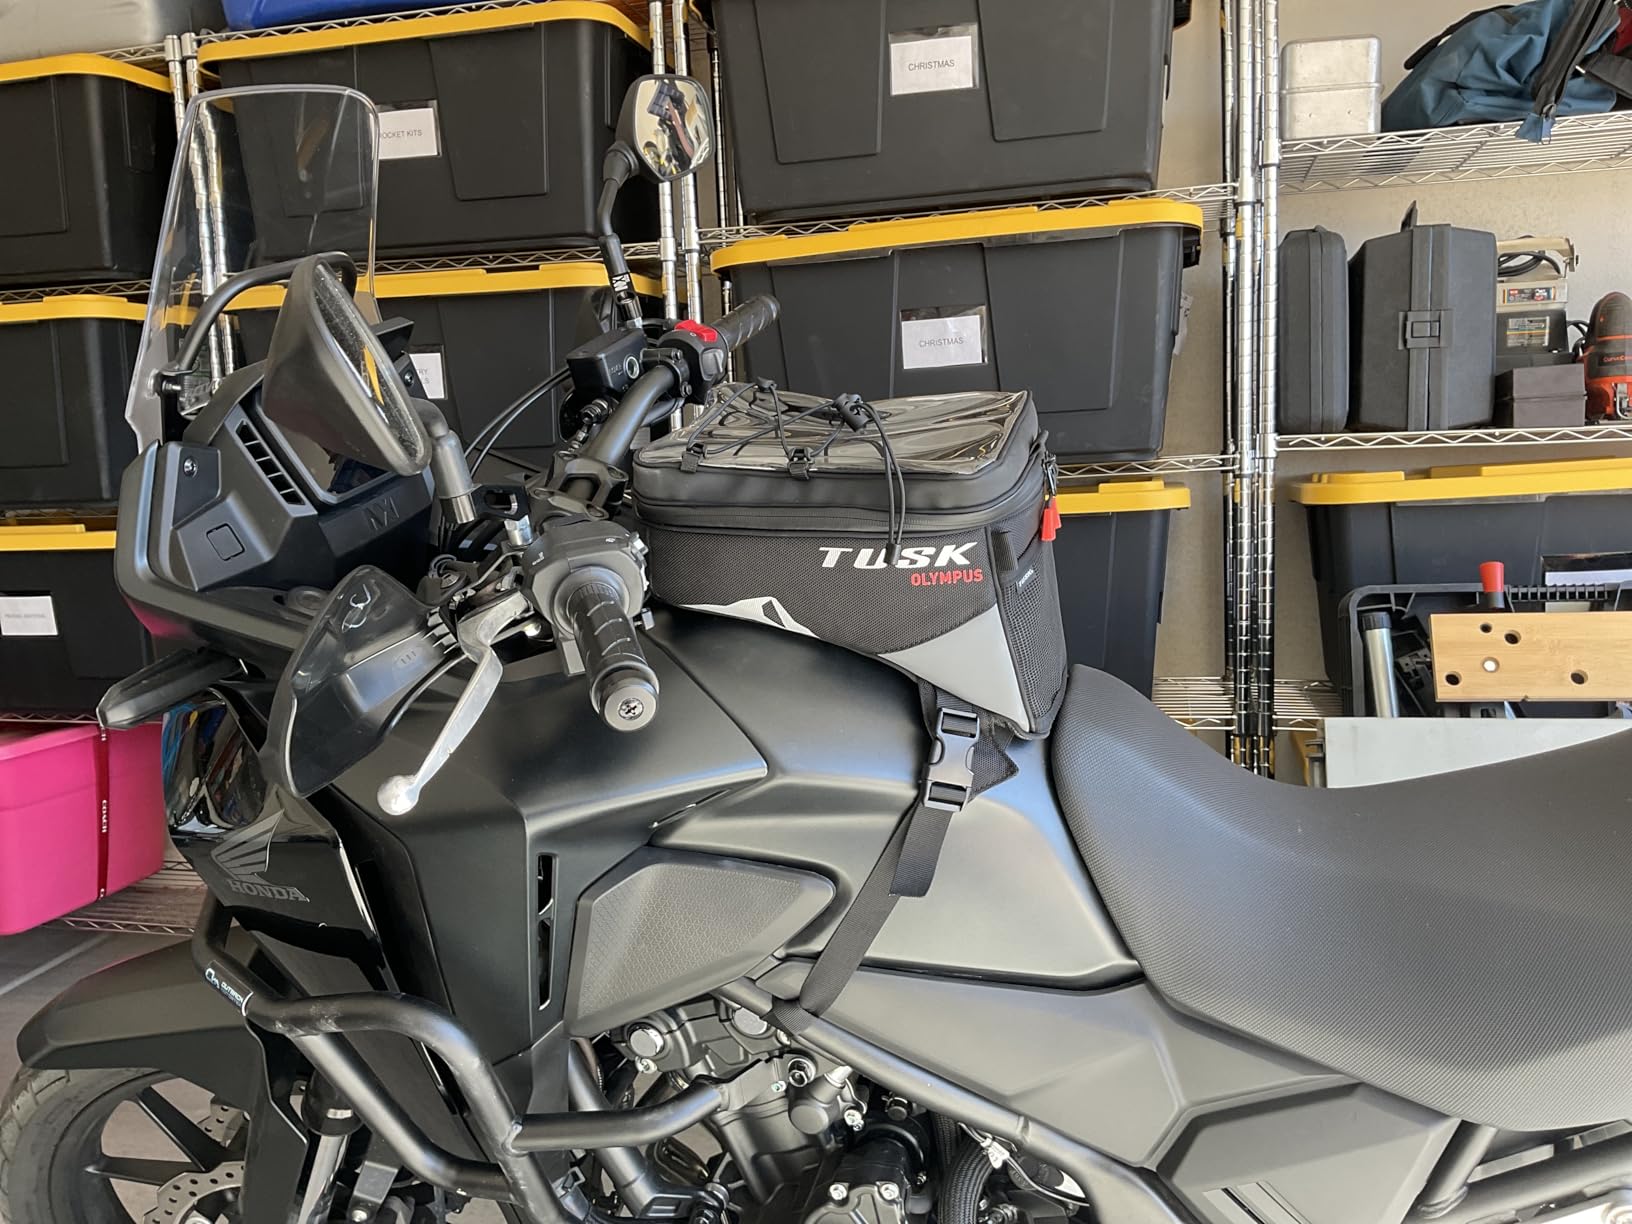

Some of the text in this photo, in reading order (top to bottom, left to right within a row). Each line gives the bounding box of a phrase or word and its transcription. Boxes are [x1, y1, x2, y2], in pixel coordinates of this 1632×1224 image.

[908, 59, 955, 71] CHRISTMAS
[381, 129, 424, 139] OCKET KITS
[919, 336, 964, 348] CHRISTMAS
[818, 541, 978, 569] TUSK
[911, 568, 984, 586] OLYMPUS
[226, 879, 308, 902] HONDA
